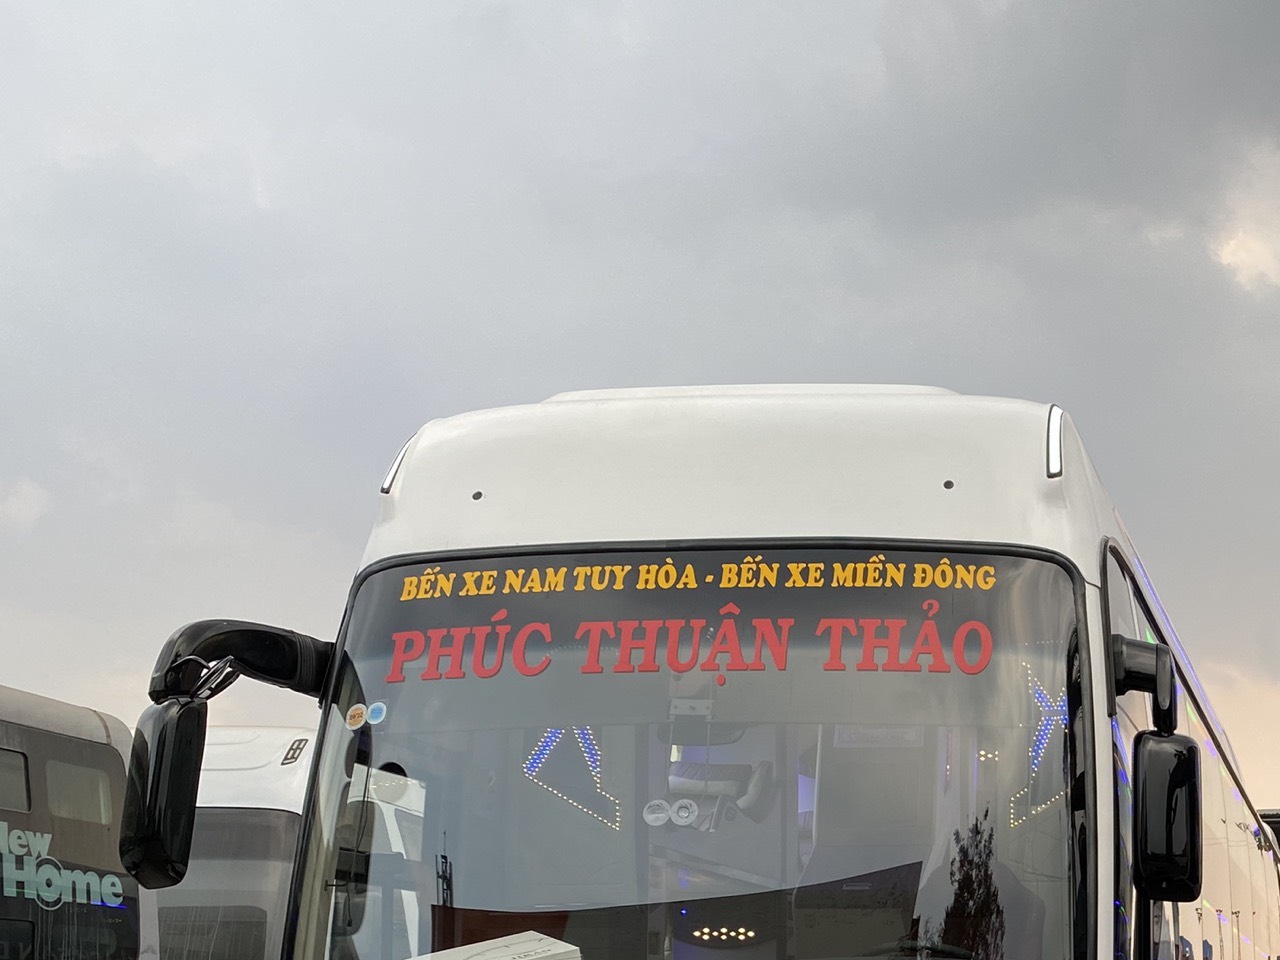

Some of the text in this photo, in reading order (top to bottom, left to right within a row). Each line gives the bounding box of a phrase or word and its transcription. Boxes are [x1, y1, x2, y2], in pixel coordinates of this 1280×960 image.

[400, 567, 456, 601] BẾN
[459, 571, 498, 596] XE
[502, 567, 568, 593] NAM
[573, 565, 631, 591] TUY
[636, 557, 698, 589] HÒA
[719, 555, 780, 588] BẾN
[785, 563, 825, 588] XE
[831, 554, 907, 587] MIỀN
[912, 557, 997, 590] ĐÔNG
[385, 598, 994, 686] PHÚC THUẬN THẢO
[2, 852, 124, 908] Home
